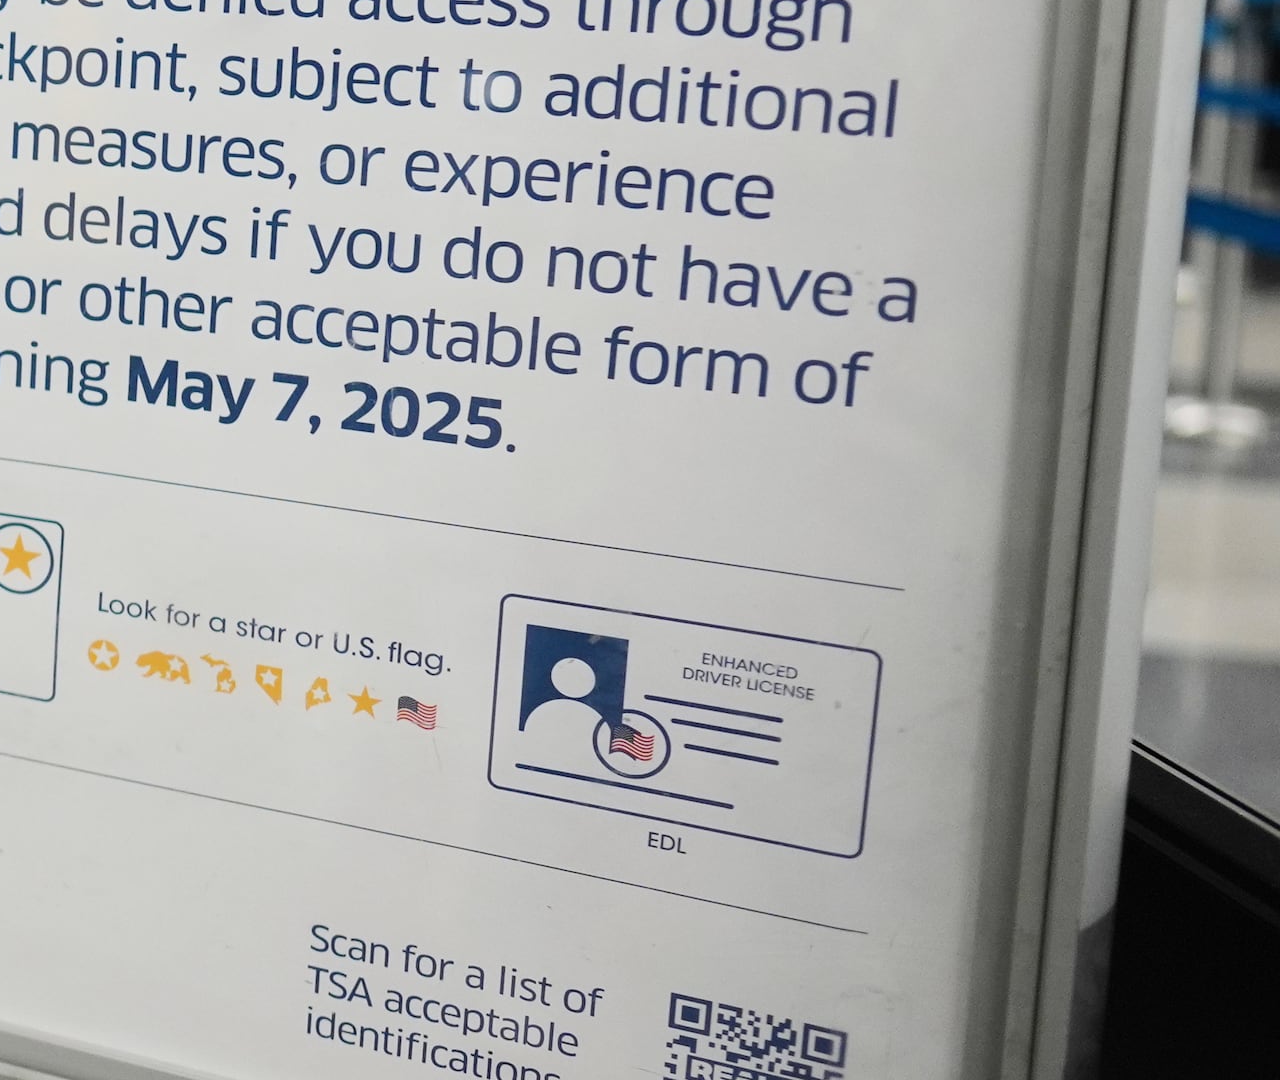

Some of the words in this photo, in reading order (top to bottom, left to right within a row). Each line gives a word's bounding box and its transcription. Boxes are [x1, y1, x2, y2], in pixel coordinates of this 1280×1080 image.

[219, 46, 439, 111] subject
[459, 58, 522, 113] to
[545, 64, 899, 138] additional
[12, 122, 297, 190] measures,
[320, 144, 386, 187] or
[405, 150, 774, 219] experience
[44, 192, 227, 261] delays
[250, 207, 291, 260] if
[308, 224, 421, 274] you
[444, 226, 523, 283] do
[547, 244, 657, 297] not
[679, 245, 853, 317] have
[878, 277, 917, 323] a
[5, 275, 62, 315] or
[80, 276, 233, 334] other
[251, 300, 581, 375] acceptable
[604, 326, 769, 397] form
[795, 351, 874, 407] of
[127, 355, 256, 424] May
[272, 372, 321, 435] 7,
[341, 381, 516, 453] 2025.
[98, 592, 157, 621] Look
[166, 604, 200, 628] for
[209, 617, 226, 633] a
[236, 618, 286, 643] star
[295, 631, 323, 649] or
[334, 632, 380, 660] U.S.
[388, 641, 451, 676] flag.
[702, 653, 798, 680] ENHANCED
[683, 667, 742, 688] DRIVER
[747, 679, 814, 701] LICENSE
[648, 832, 686, 854] EDL
[307, 965, 373, 1007] TSA
[384, 988, 579, 1057] acceptable
[310, 924, 389, 968] Scan
[402, 944, 454, 981] for
[465, 965, 484, 990] a
[499, 966, 552, 1006] list
[564, 988, 605, 1017] of
